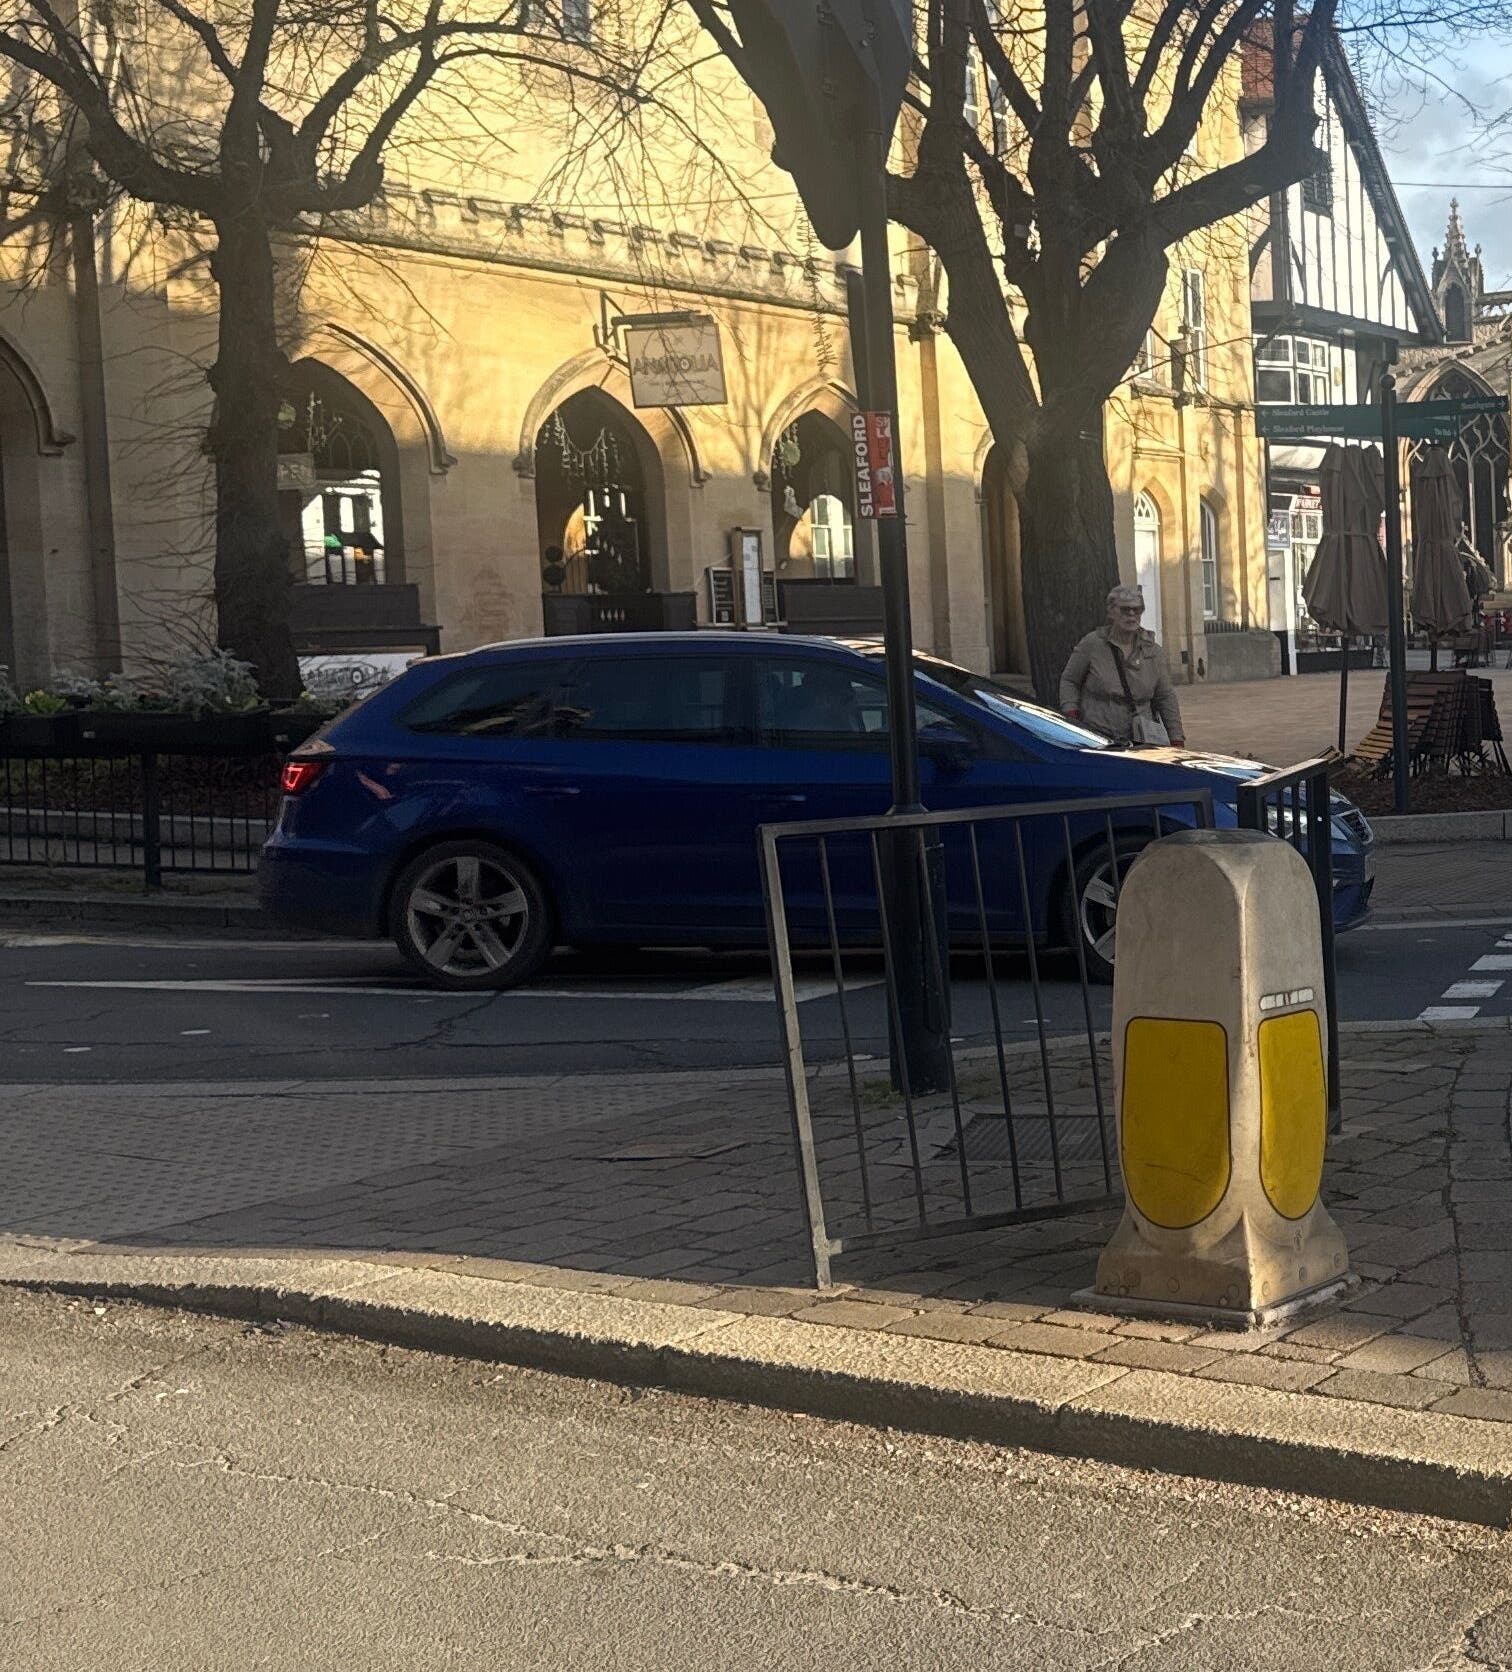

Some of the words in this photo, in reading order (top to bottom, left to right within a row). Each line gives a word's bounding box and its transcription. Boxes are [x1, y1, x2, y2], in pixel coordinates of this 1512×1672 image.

[1272, 408, 1304, 417] Sleaford
[1305, 408, 1330, 417] Castle
[1273, 424, 1306, 434] Sleaford
[853, 415, 874, 518] SLEAFORD
